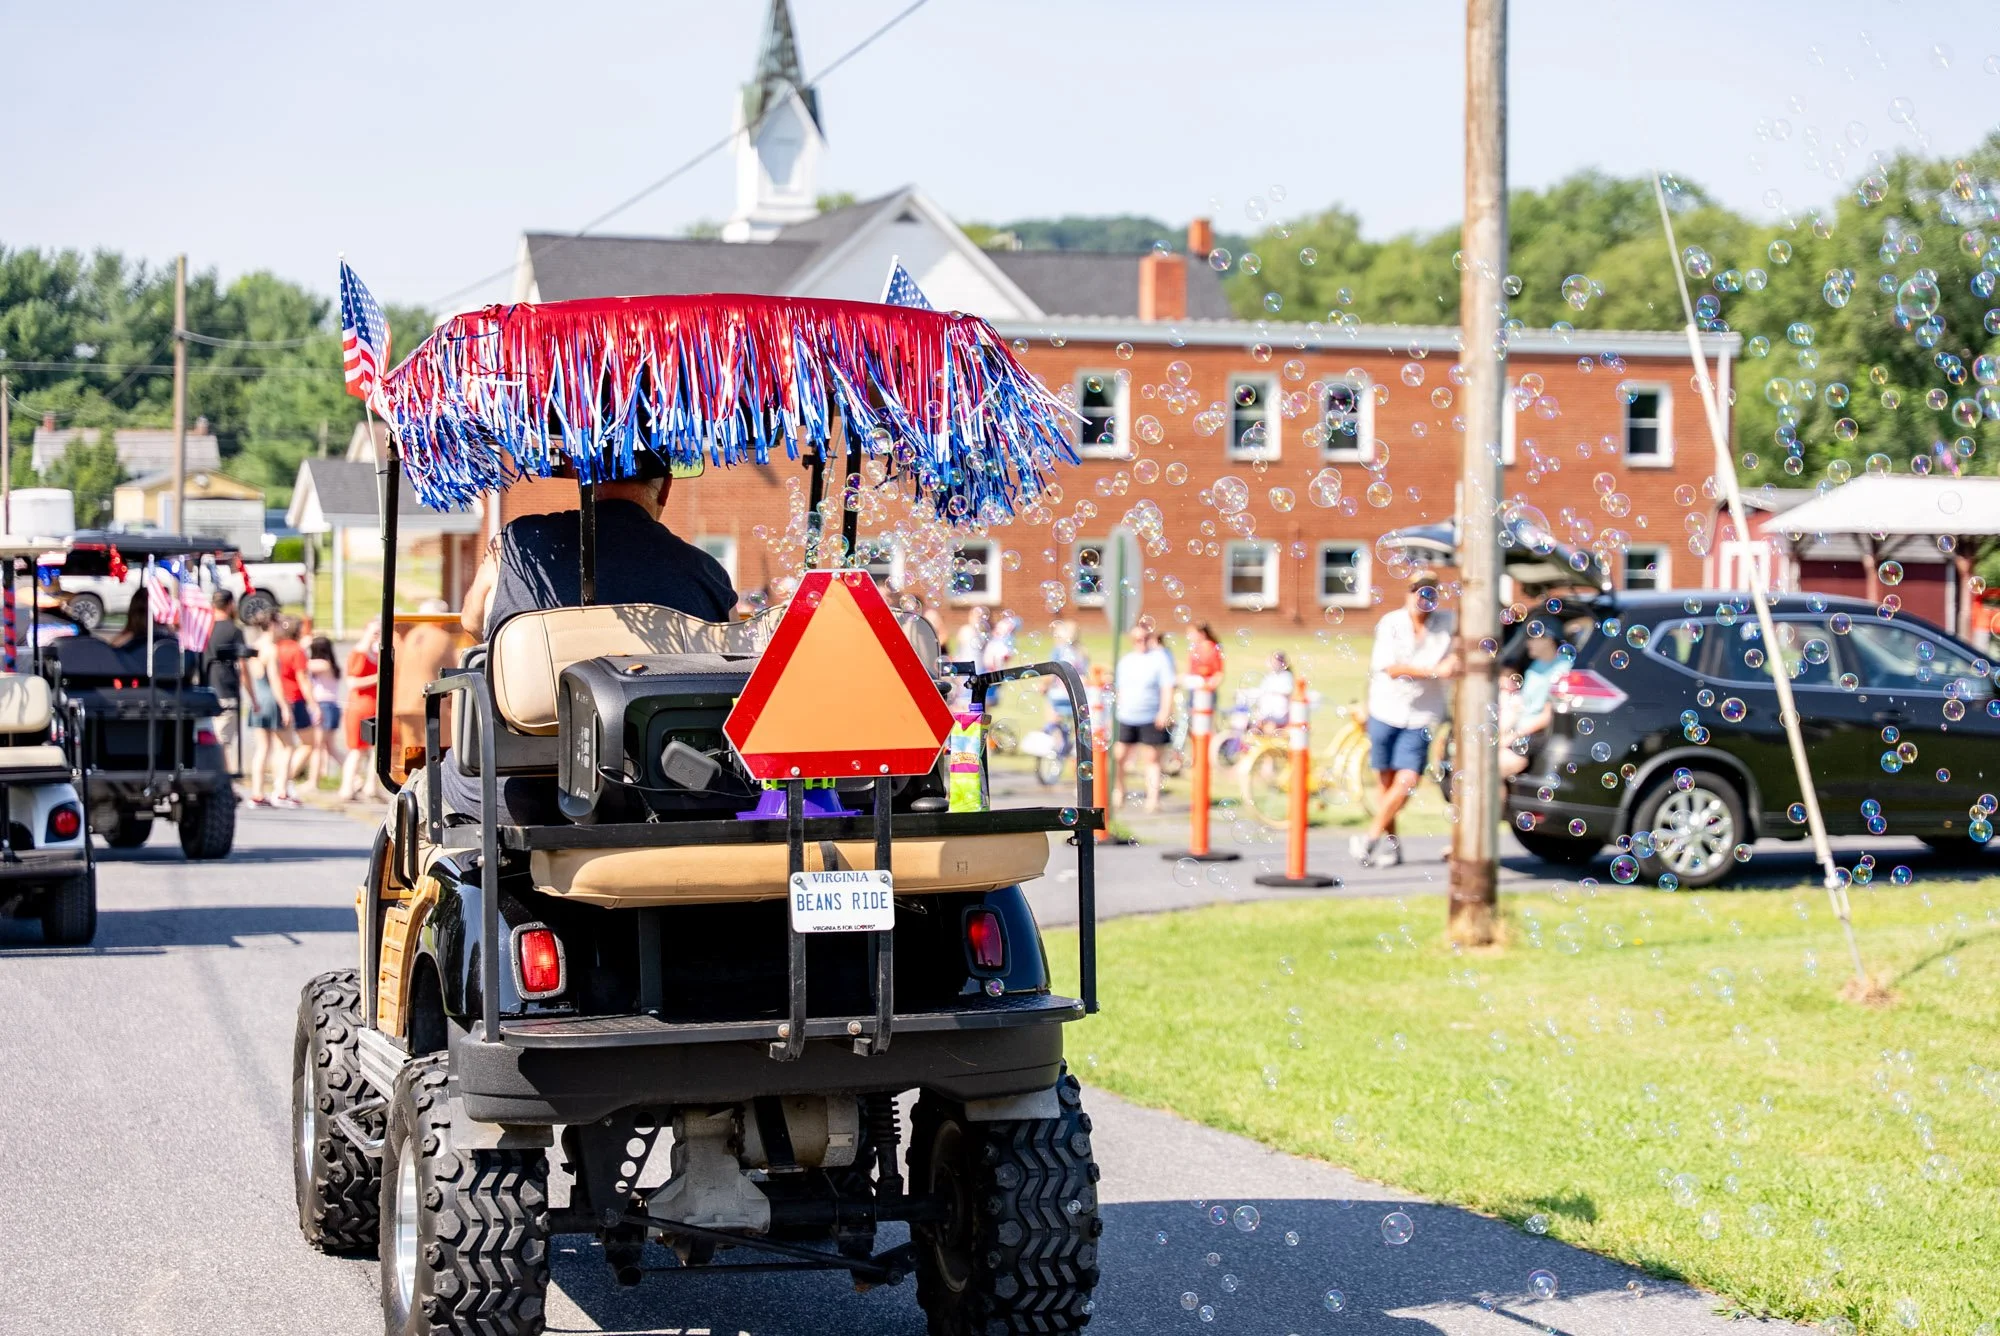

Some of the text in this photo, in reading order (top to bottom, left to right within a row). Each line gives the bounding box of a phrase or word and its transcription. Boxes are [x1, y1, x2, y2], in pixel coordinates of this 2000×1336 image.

[812, 872, 869, 883] VIRGINIA
[797, 891, 889, 911] BEANS RIDE
